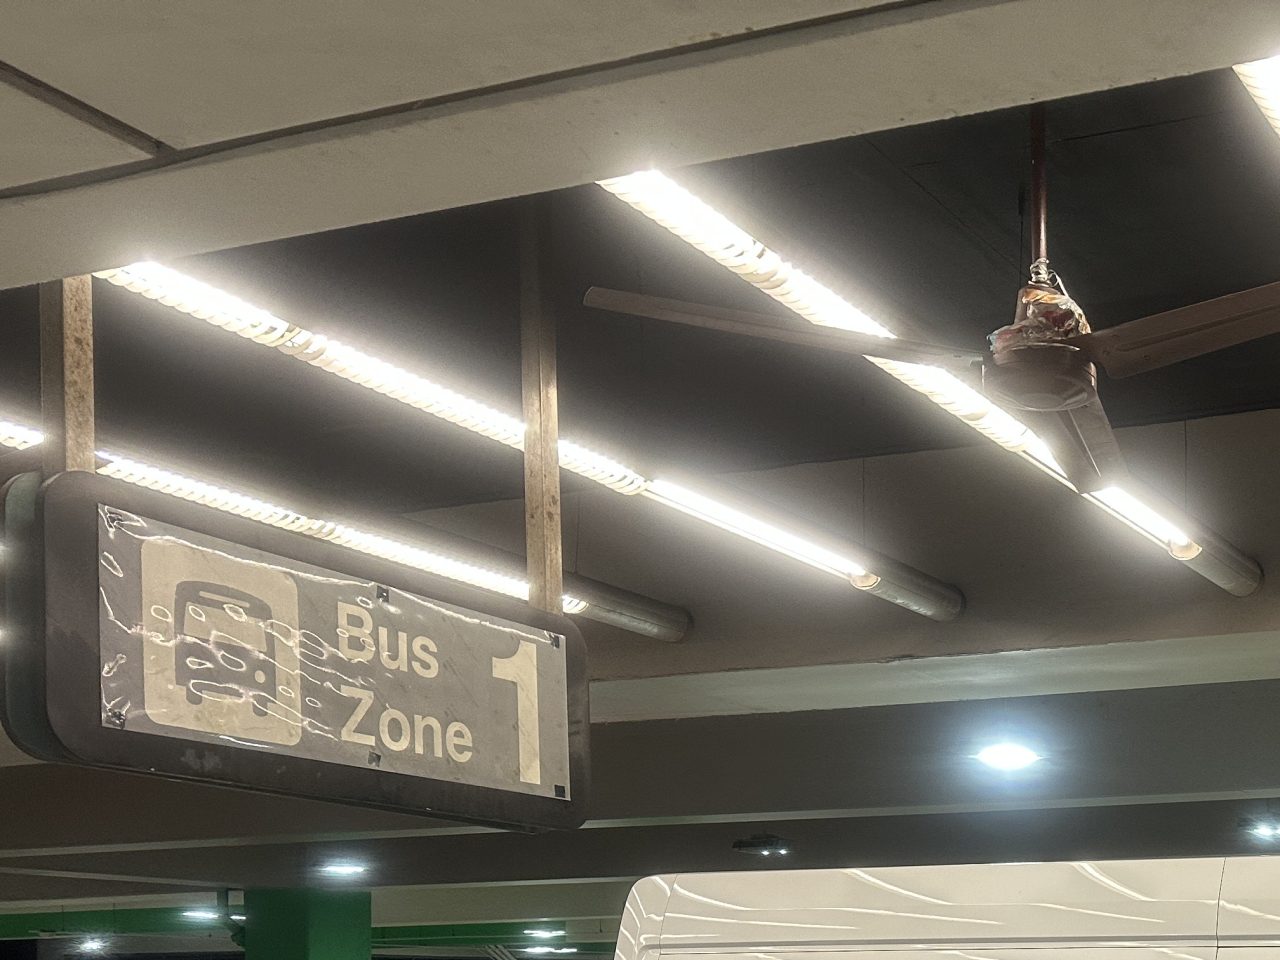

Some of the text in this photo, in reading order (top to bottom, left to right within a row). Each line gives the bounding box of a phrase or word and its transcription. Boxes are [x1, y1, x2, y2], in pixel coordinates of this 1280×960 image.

[336, 601, 439, 679] Bus
[340, 684, 473, 763] Zone
[491, 639, 541, 785] 1
